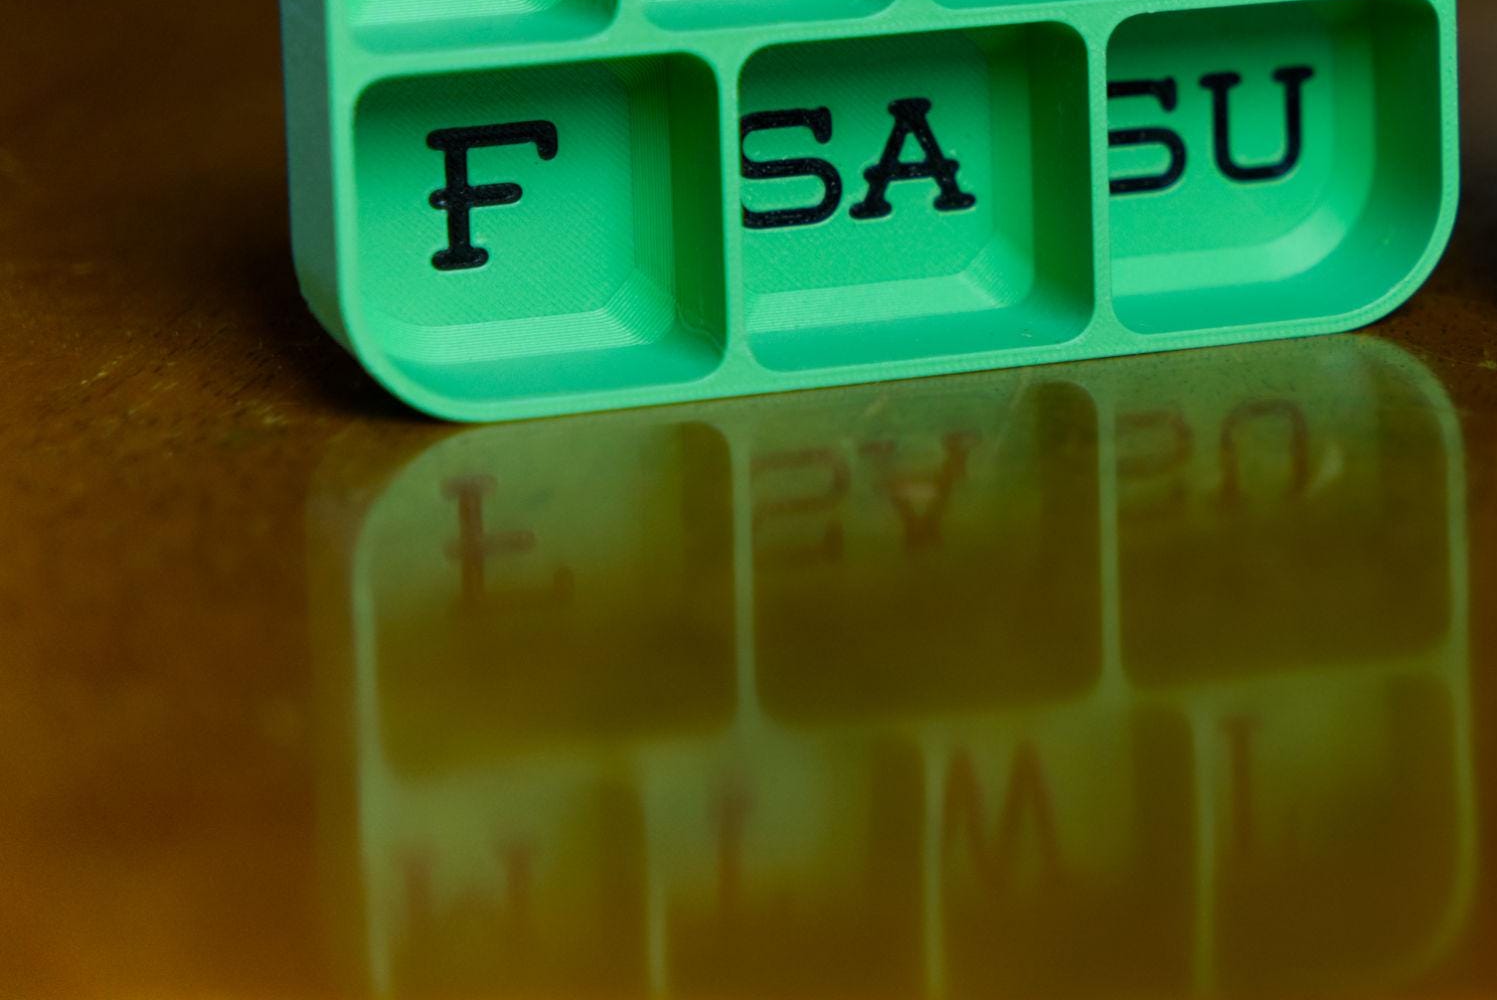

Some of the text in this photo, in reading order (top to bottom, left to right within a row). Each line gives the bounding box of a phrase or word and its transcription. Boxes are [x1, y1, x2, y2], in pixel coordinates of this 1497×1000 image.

[425, 63, 1315, 271] F SA SU
